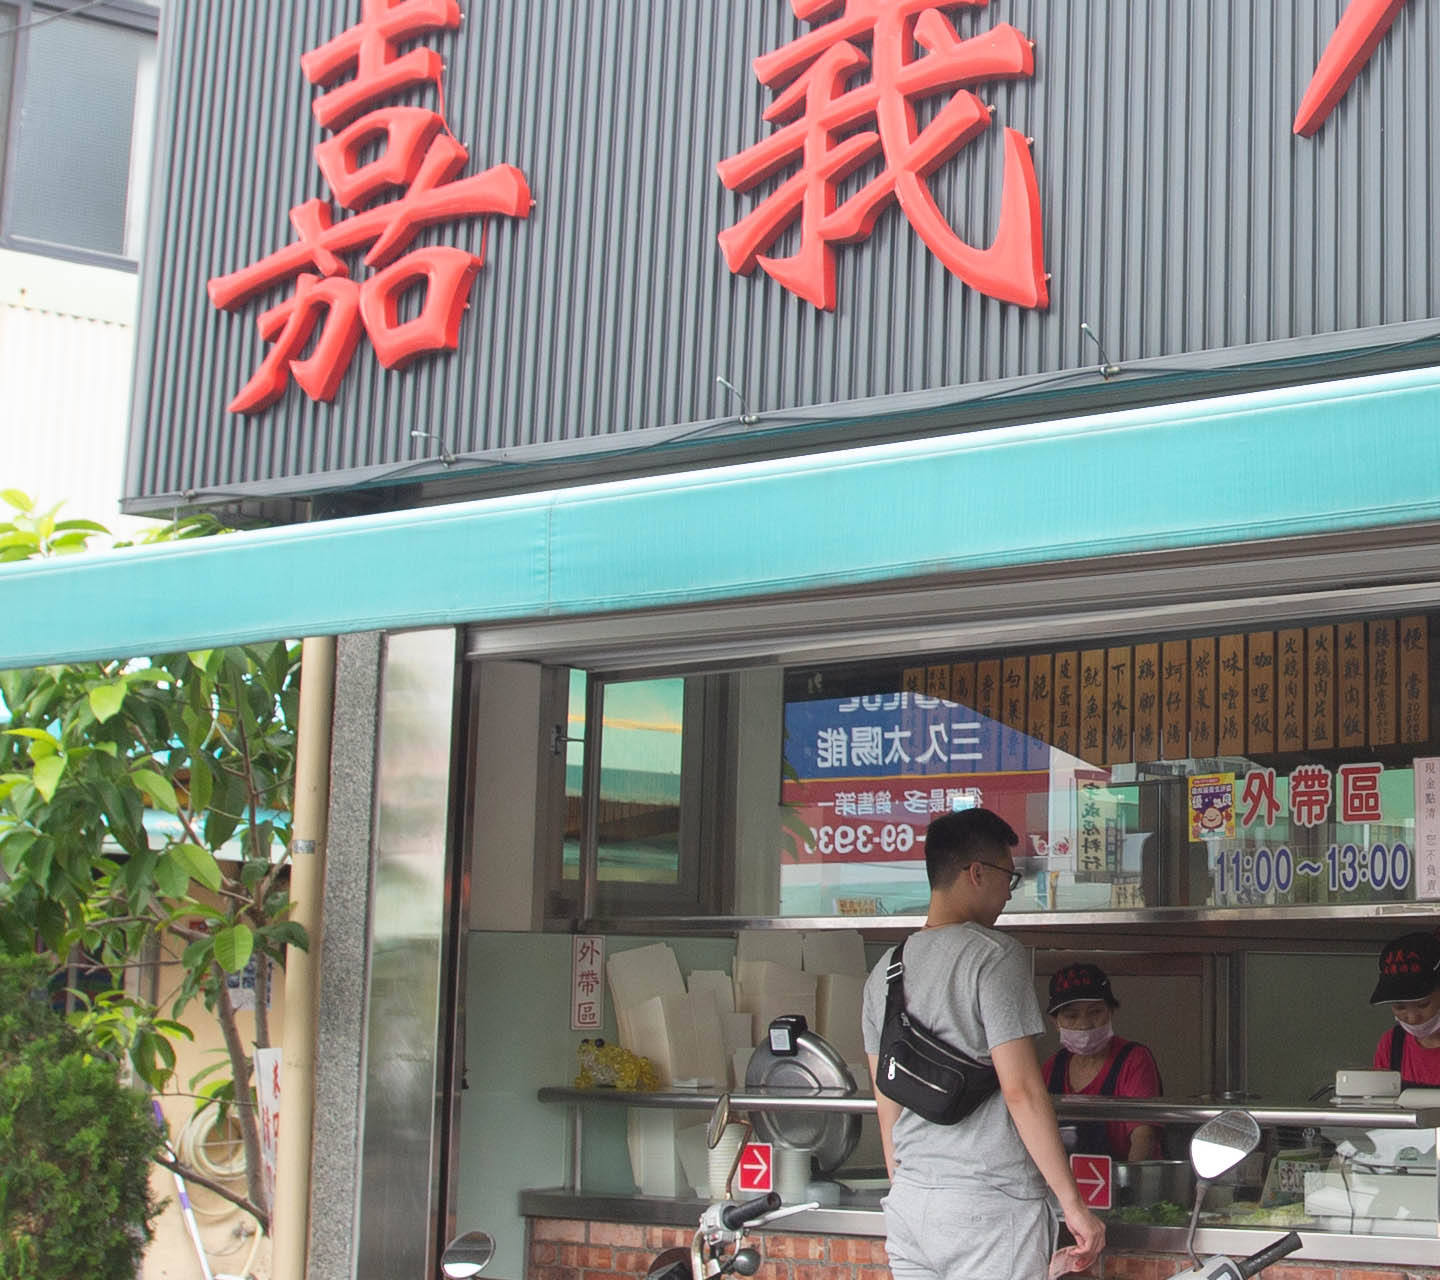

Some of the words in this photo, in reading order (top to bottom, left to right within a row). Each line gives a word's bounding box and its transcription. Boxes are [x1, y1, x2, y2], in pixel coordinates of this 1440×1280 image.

[1242, 764, 1383, 828] 外帶區
[577, 939, 601, 1025] 外帶區
